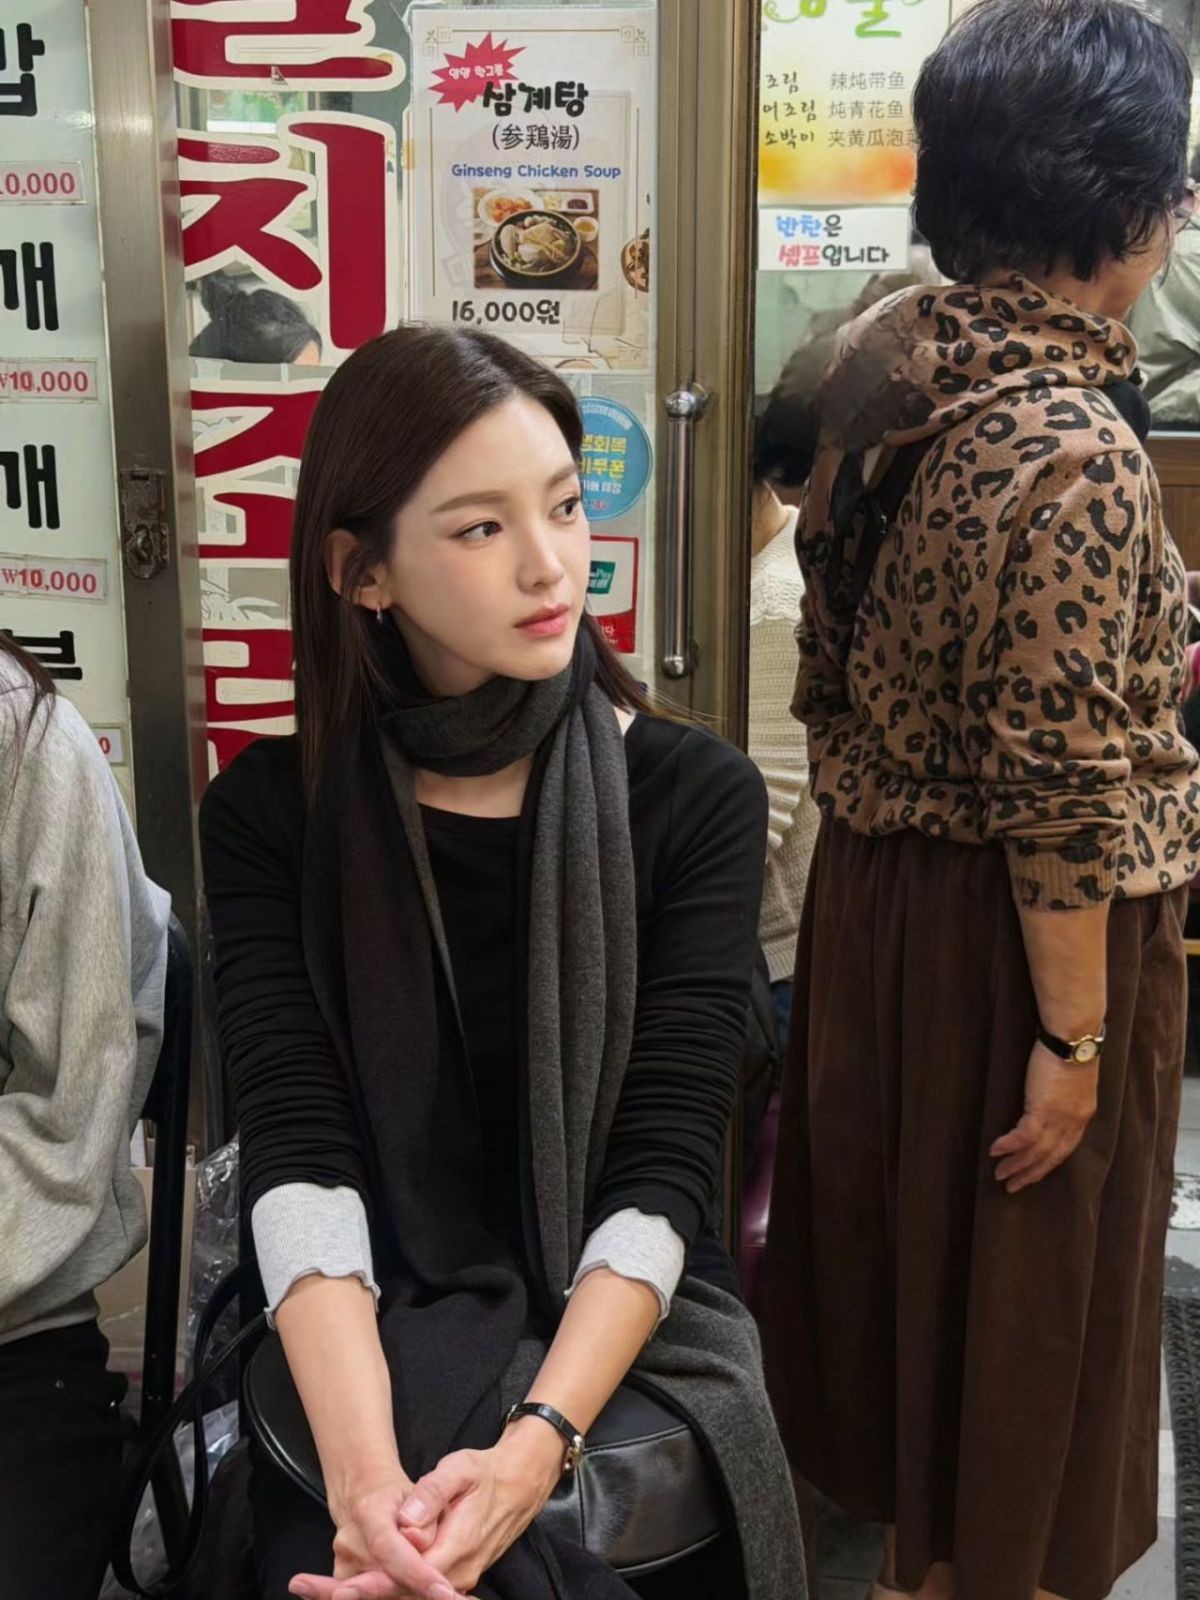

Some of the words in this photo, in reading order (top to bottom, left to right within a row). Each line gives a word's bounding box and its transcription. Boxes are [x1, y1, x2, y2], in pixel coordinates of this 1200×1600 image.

[482, 81, 589, 118] 삼계탕
[452, 164, 512, 179] Ginseng
[518, 164, 578, 178] Chicken
[584, 164, 621, 179] Soup
[0, 172, 76, 196] 0,000
[776, 214, 843, 238] 반찬은
[778, 244, 890, 266] 셀프입니다
[451, 300, 561, 325] 16,000원
